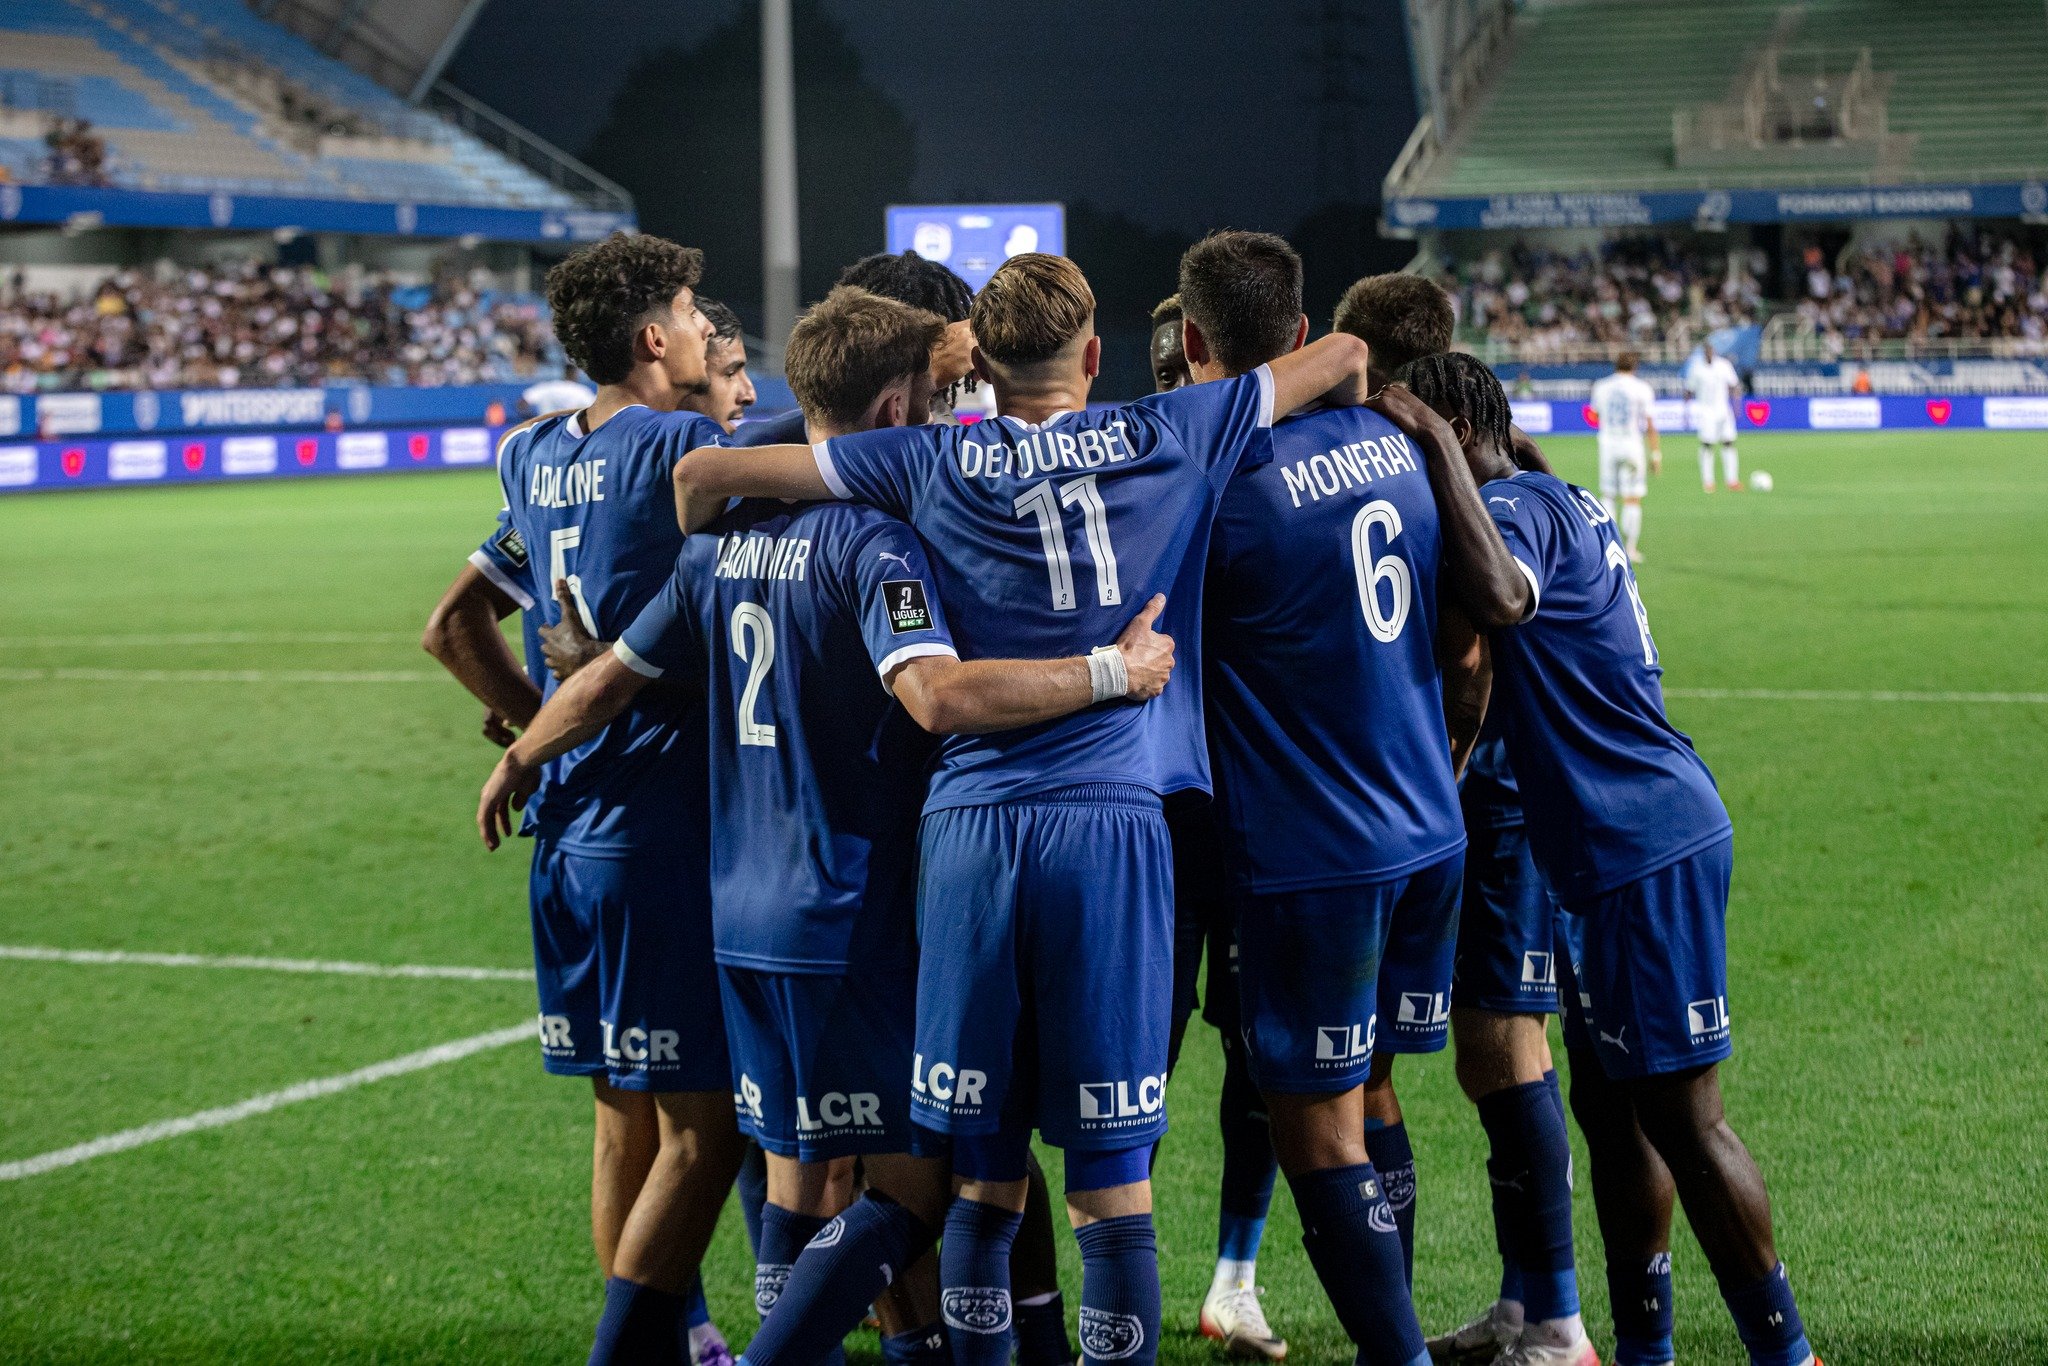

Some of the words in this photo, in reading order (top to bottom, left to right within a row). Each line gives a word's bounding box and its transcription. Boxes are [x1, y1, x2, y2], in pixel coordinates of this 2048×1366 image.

[1280, 433, 1417, 508] MONFRAY
[1013, 473, 1121, 611] 11
[550, 525, 599, 640] 5
[1351, 499, 1412, 643] 6
[900, 586, 912, 610] 2
[731, 601, 776, 747] 2
[603, 1022, 680, 1062] LCR
[912, 1052, 987, 1105] LCR
[797, 1091, 884, 1131] LCR
[1365, 1181, 1374, 1196] 6
[1643, 1297, 1659, 1312] 14
[1767, 1310, 1783, 1327] 14
[925, 1333, 942, 1349] 15
